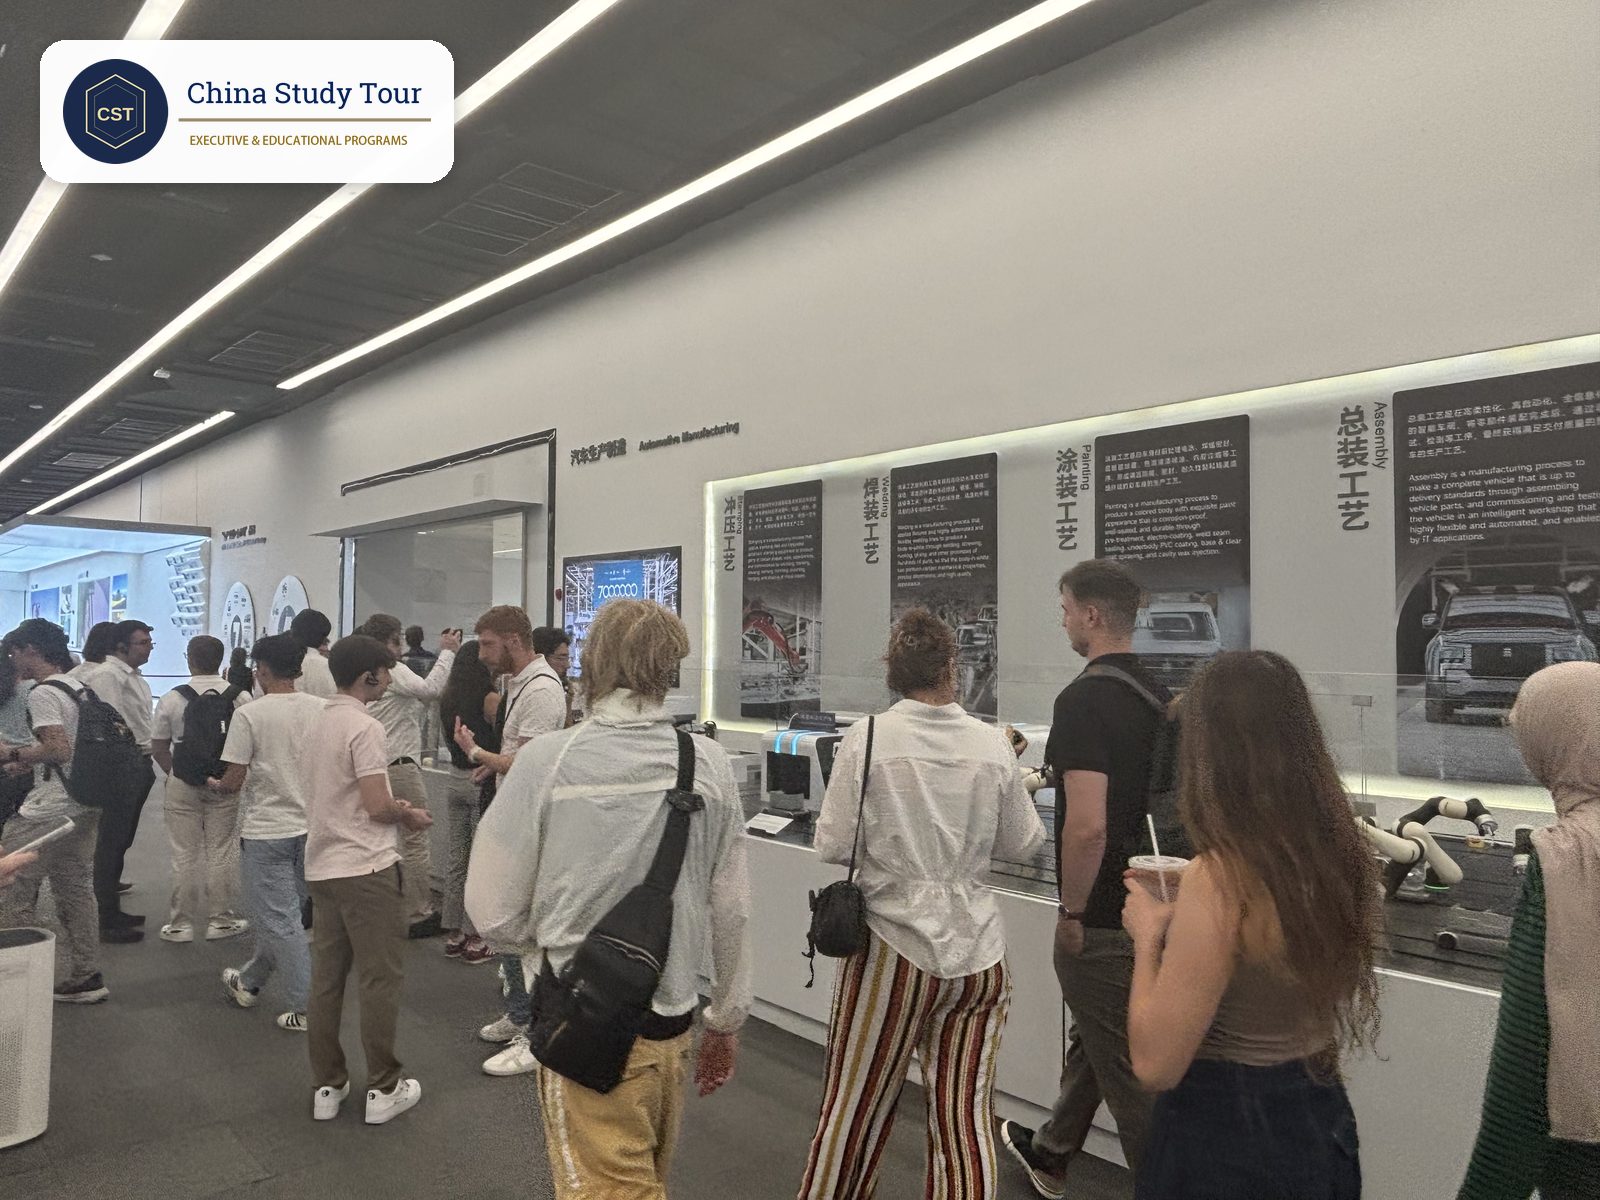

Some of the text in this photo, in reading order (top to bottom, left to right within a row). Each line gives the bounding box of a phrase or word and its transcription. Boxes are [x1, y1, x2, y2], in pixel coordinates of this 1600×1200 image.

[1373, 401, 1389, 470] Assembly
[1080, 444, 1092, 491] Painting
[1337, 404, 1369, 531] 总装工艺
[1408, 471, 1447, 482] Assembly
[1468, 464, 1532, 476] manufacturing
[1535, 461, 1572, 472] process
[1408, 484, 1431, 492] make
[1440, 479, 1481, 489] complete
[1483, 476, 1515, 485] vehicle
[1518, 474, 1535, 482] that
[881, 476, 890, 518] Welding
[1055, 447, 1078, 551] 涂装工艺
[1408, 494, 1440, 502] delivery
[1442, 490, 1485, 499] standards
[1488, 486, 1523, 496] through
[1408, 503, 1438, 512] vehicle
[1466, 500, 1483, 508] and
[1486, 495, 1553, 507] commissioning
[1556, 493, 1574, 501] and
[1425, 513, 1454, 521] vehicle
[1481, 508, 1525, 518] intelligent
[1528, 505, 1573, 514] workshop
[1577, 503, 1596, 511] that
[1409, 525, 1434, 533] highly
